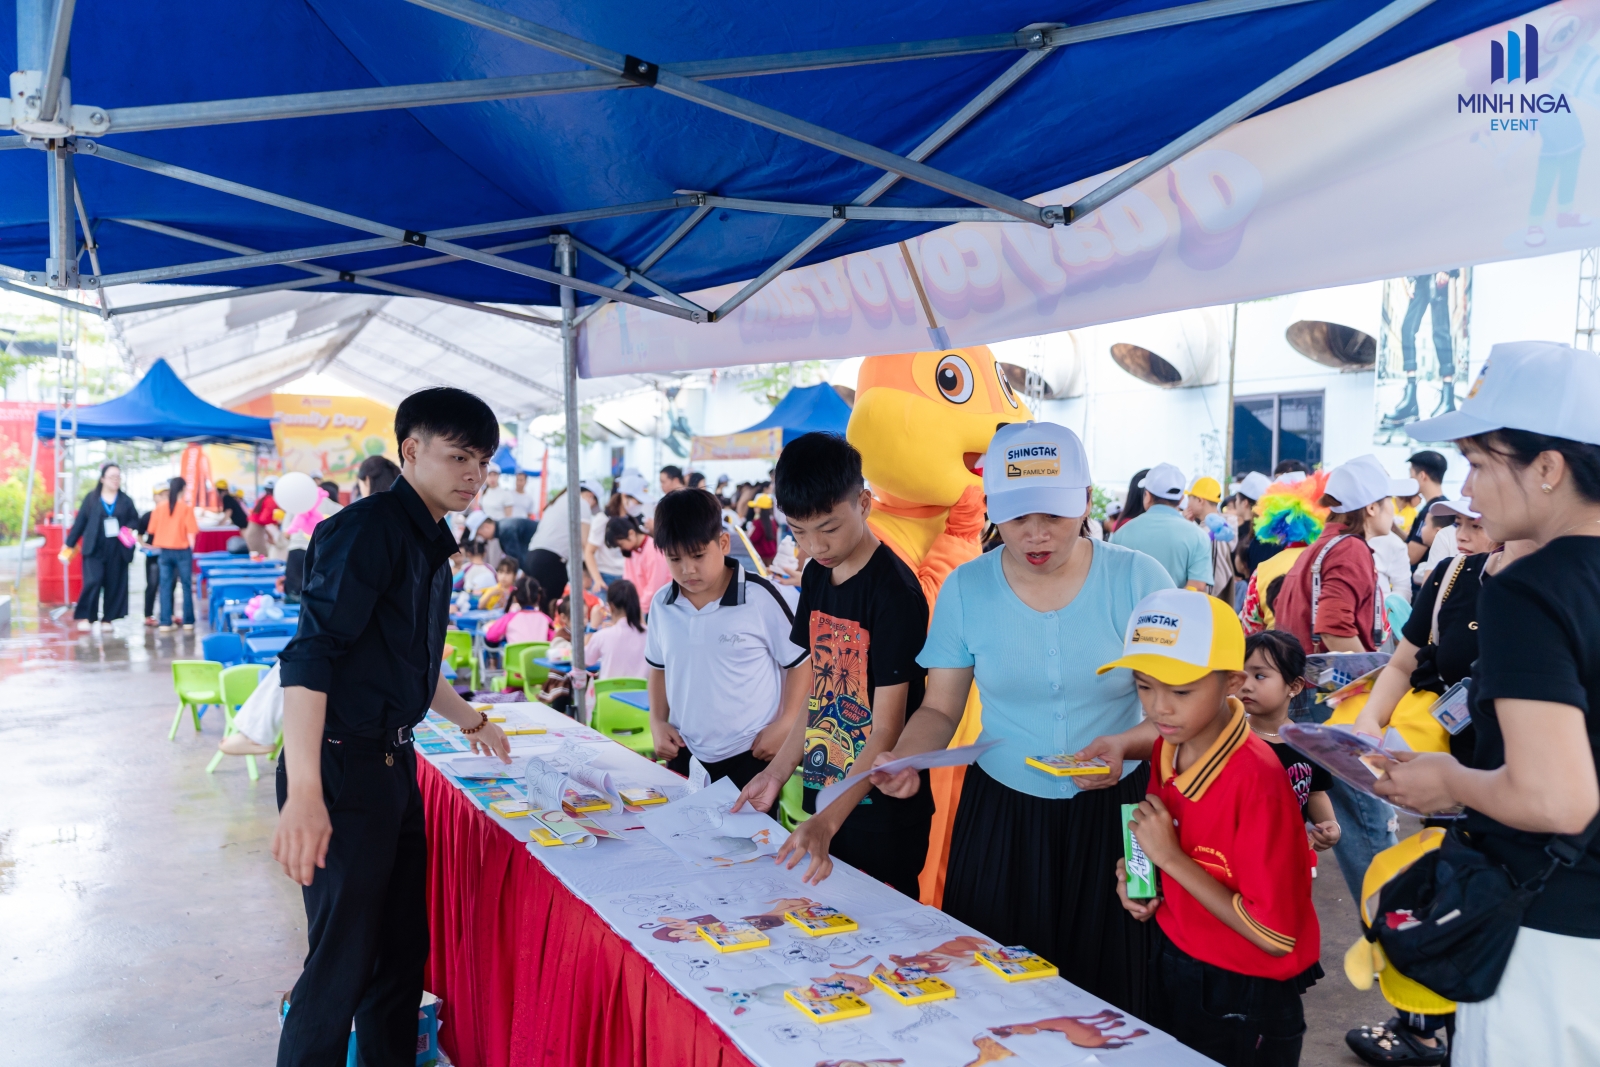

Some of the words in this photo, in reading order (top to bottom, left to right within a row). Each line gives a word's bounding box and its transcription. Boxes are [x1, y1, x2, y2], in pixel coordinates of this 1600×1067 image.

[274, 411, 331, 430] Family
[332, 413, 368, 431] Day
[1008, 446, 1058, 460] SHINGTAK
[1136, 614, 1179, 628] SHINGTAK
[1140, 635, 1160, 643] FAMILY
[1160, 637, 1174, 645] DAY
[840, 699, 868, 718] THRILLER
[841, 709, 862, 723] PARK
